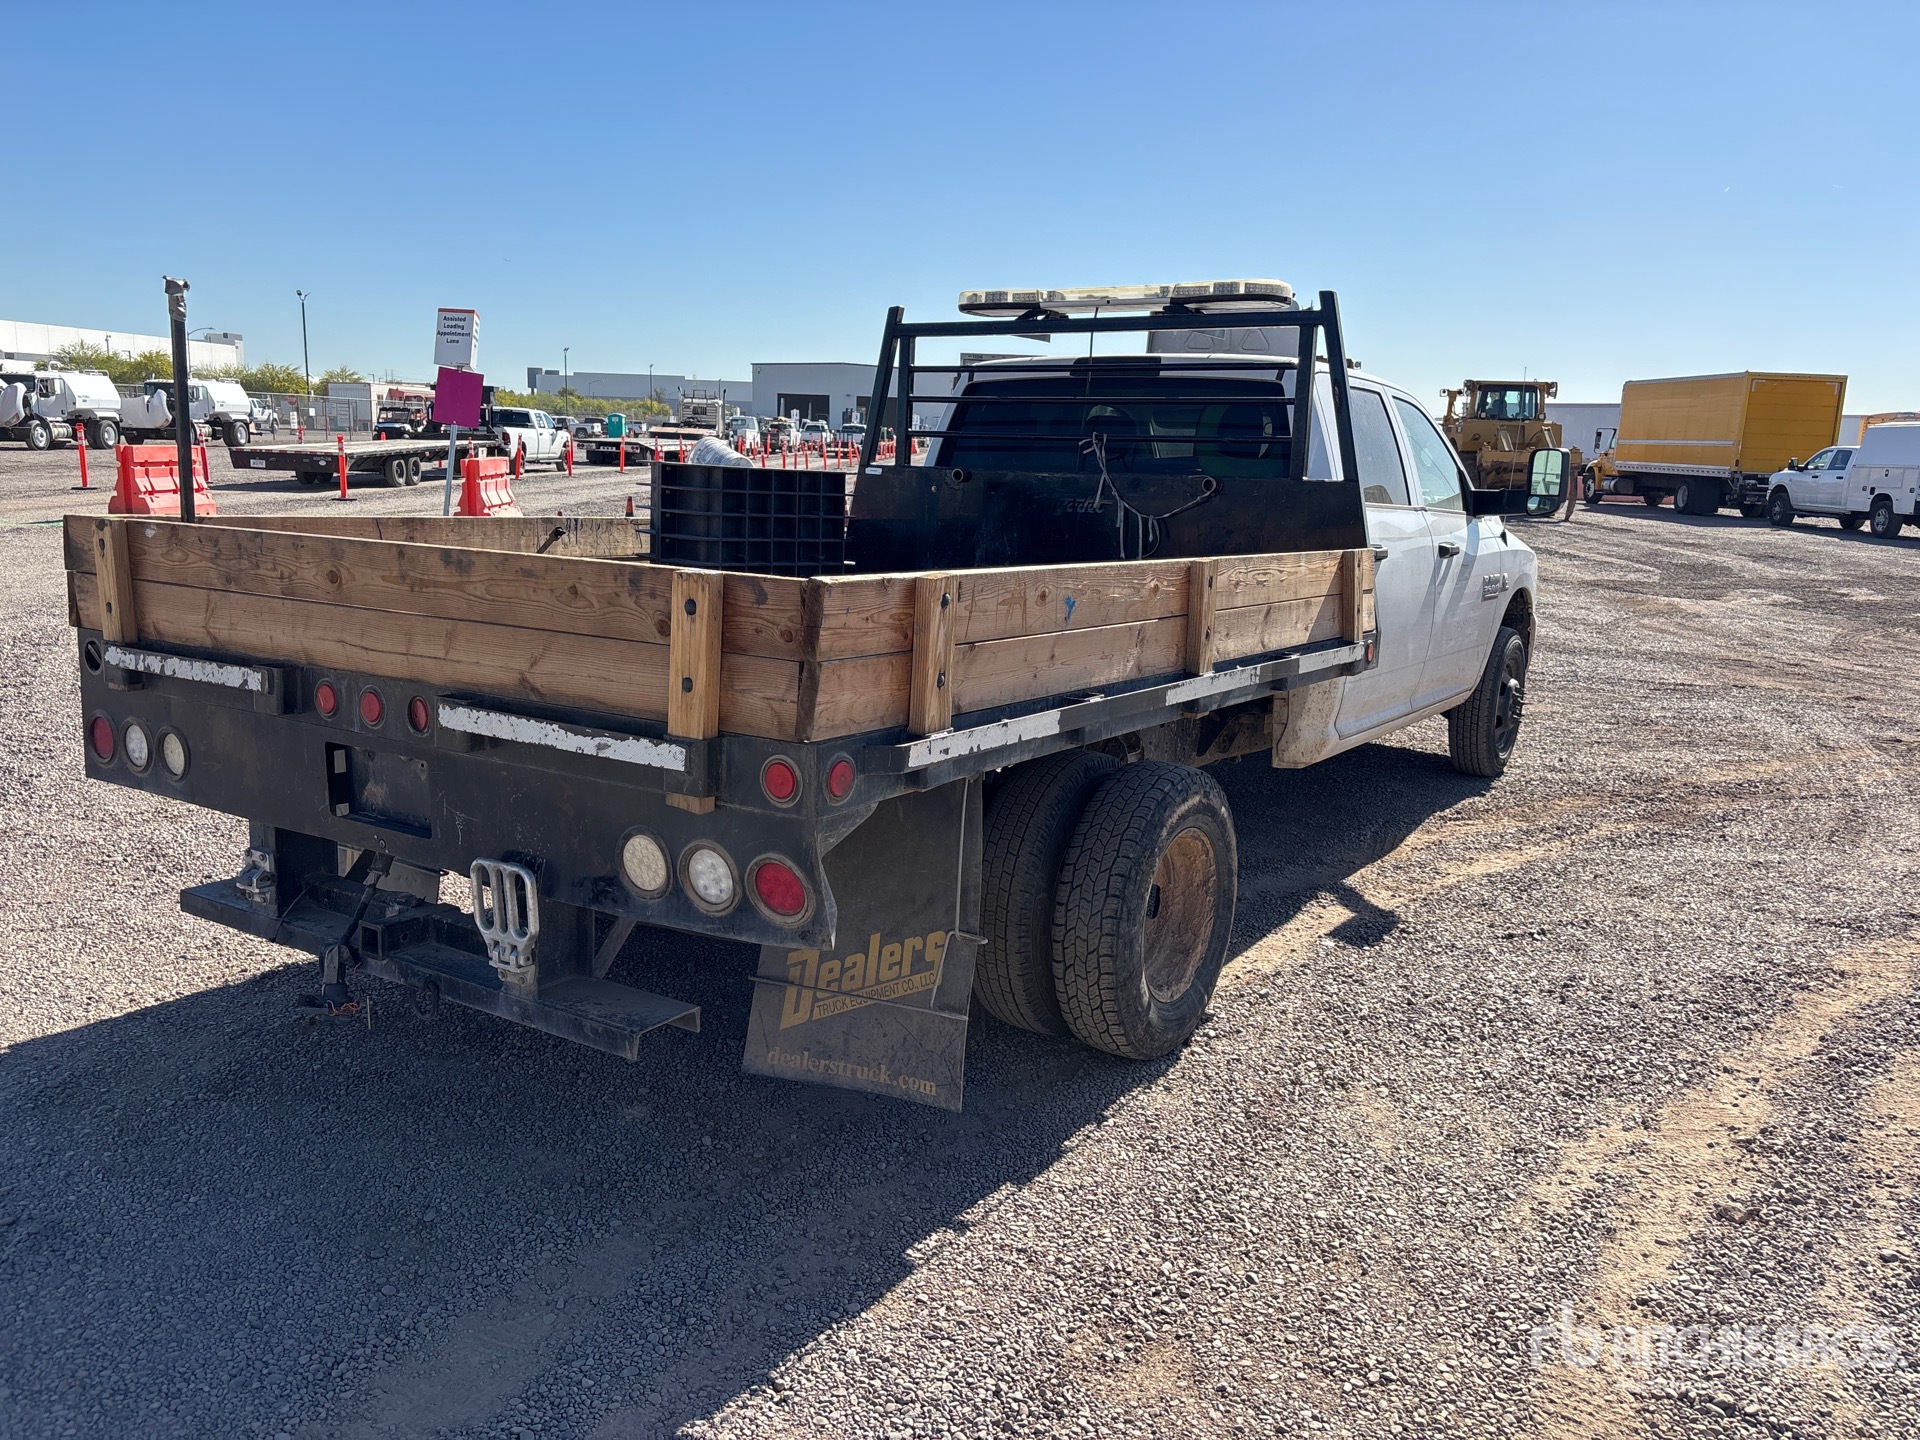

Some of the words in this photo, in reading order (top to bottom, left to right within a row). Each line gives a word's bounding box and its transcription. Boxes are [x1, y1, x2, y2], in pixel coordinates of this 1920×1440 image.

[443, 323, 465, 331] Loading
[780, 931, 947, 1030] Dealers
[816, 998, 849, 1017] TRUCK
[850, 982, 900, 1008] EQUIPMENT
[920, 972, 936, 988] LLC
[767, 1047, 937, 1096] dealerstruck.com
